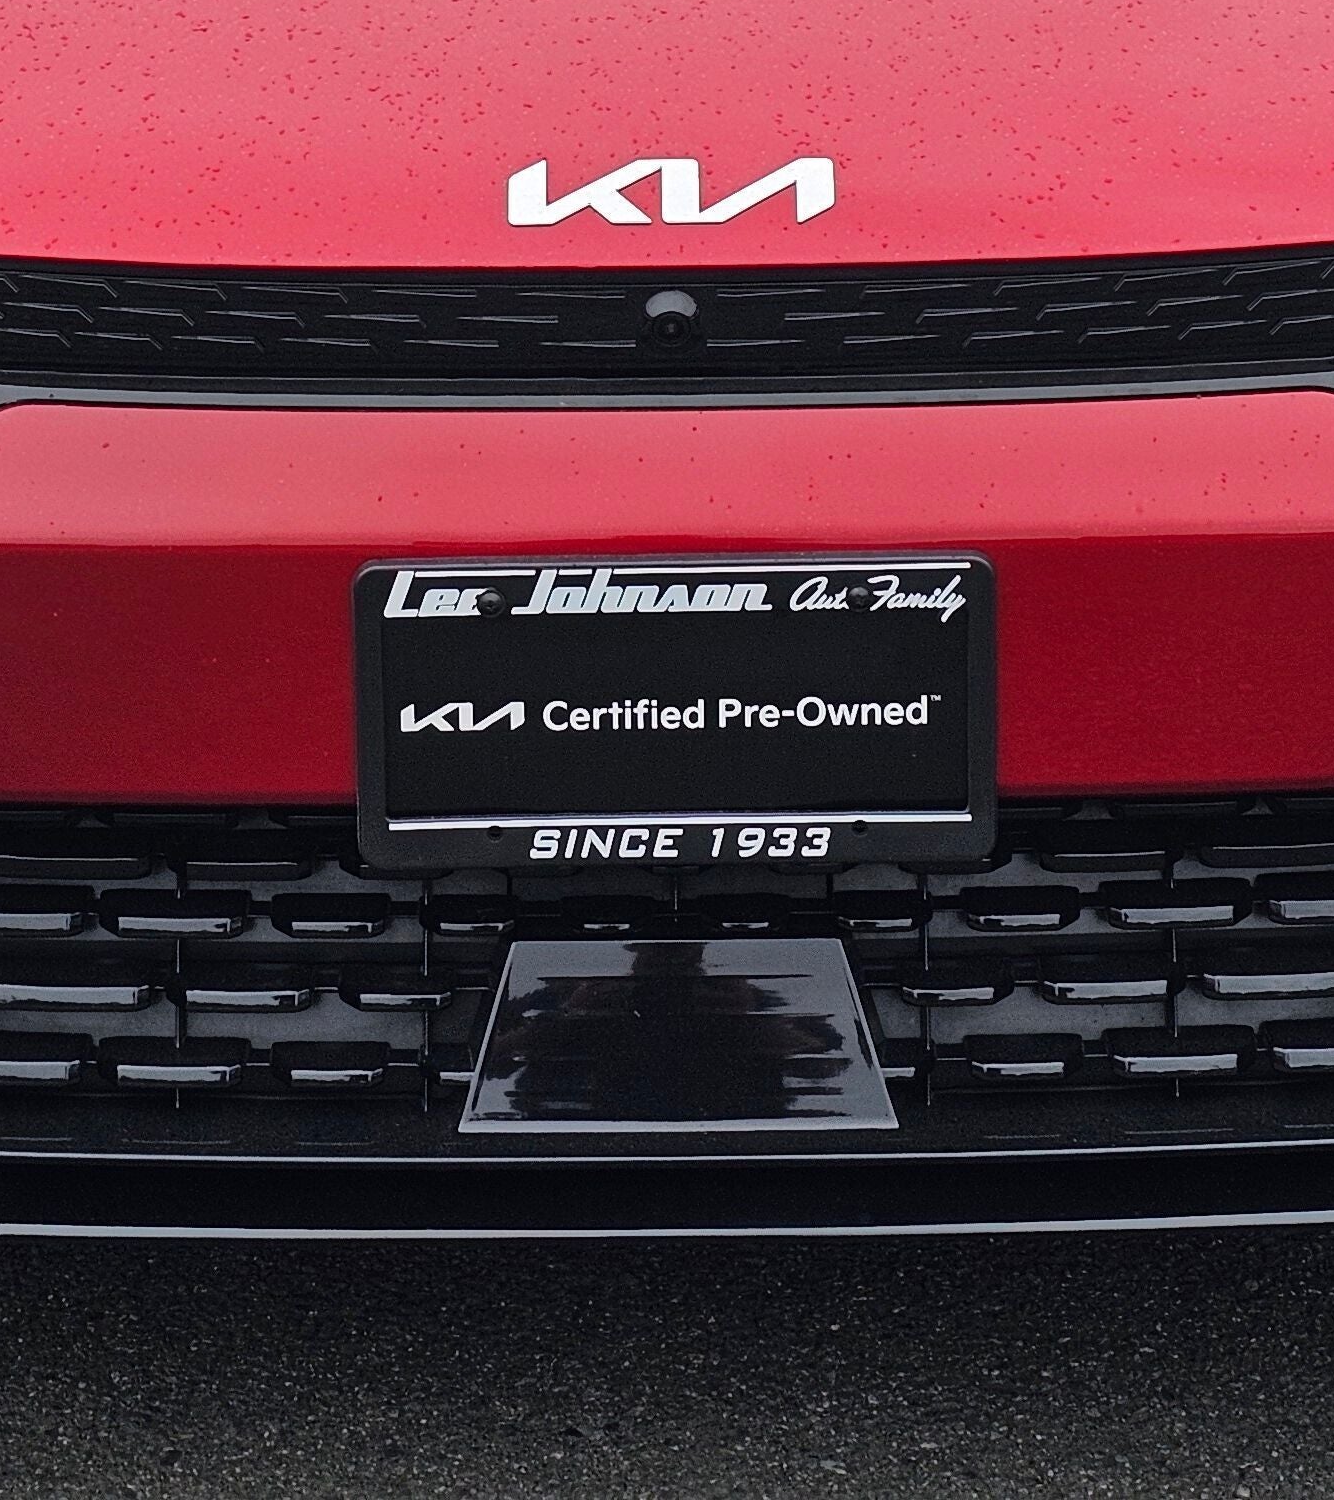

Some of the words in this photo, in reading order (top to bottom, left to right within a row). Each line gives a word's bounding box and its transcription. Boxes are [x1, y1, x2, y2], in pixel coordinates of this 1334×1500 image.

[508, 157, 836, 226] KIA
[510, 567, 773, 615] Johnson
[789, 576, 865, 612] Aut
[867, 574, 966, 623] Family
[400, 701, 526, 732] KIA
[542, 698, 705, 731] Certified
[529, 827, 684, 859] SINCE
[711, 826, 831, 858] 1933
